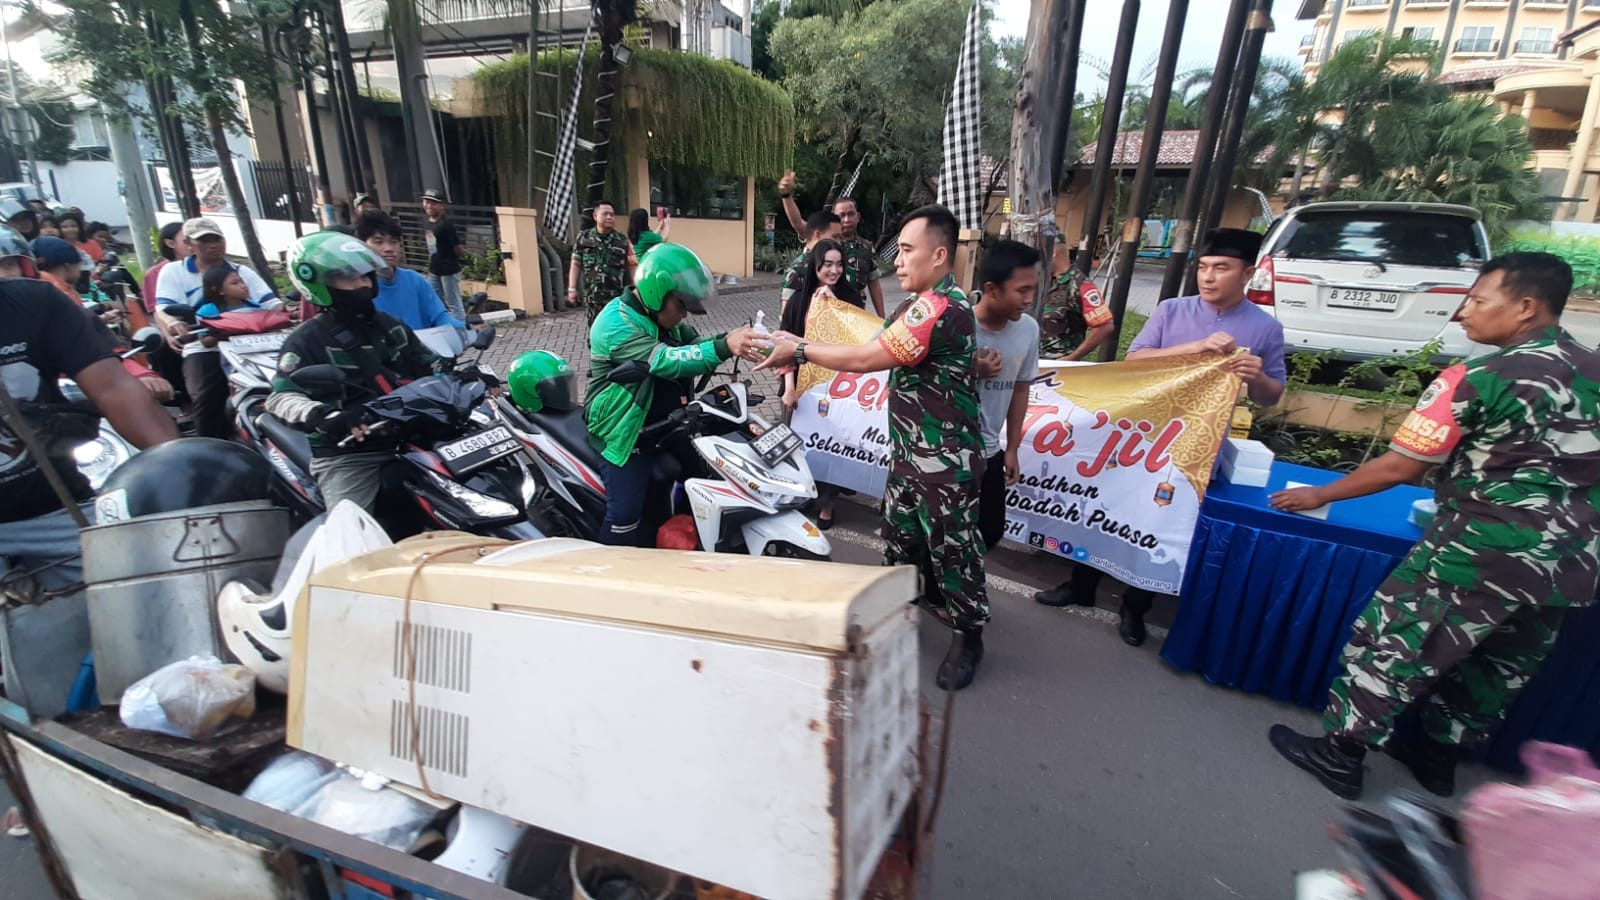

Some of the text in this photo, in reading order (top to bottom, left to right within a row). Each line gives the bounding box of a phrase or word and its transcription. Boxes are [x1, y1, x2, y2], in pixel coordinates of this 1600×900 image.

[1330, 290, 1338, 299] B
[445, 447, 457, 458] B
[460, 437, 487, 453] 4680
[485, 428, 509, 443] BRZ
[805, 431, 876, 463] Selamat
[691, 485, 713, 504] HONDA
[1086, 509, 1159, 550] Puasa
